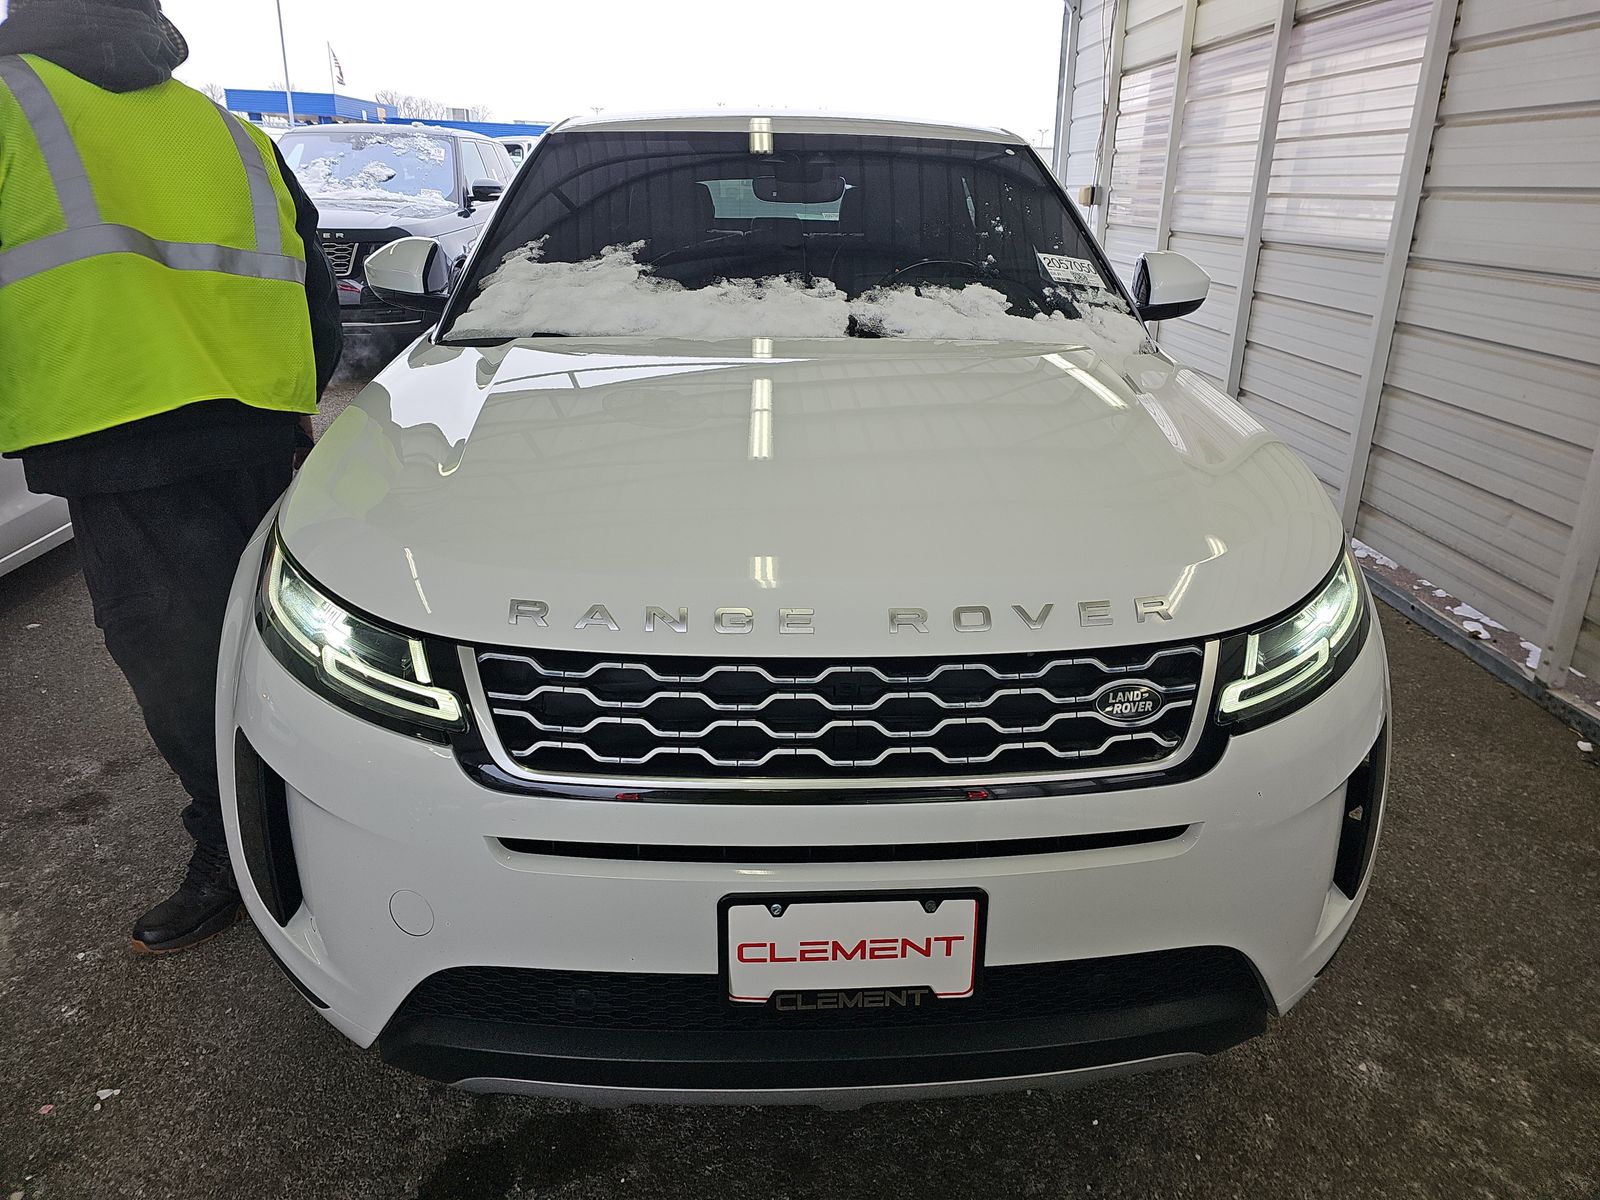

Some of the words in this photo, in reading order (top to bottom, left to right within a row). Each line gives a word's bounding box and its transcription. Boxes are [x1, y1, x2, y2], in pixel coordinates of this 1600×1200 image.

[1043, 256, 1097, 274] 2057050
[508, 599, 815, 635] RANGE
[888, 596, 1173, 634] ROVER
[1108, 690, 1142, 703] LAND
[1112, 700, 1153, 714] ROVER
[737, 935, 965, 963] CLEMENT
[775, 989, 929, 1011] CLEMENT
